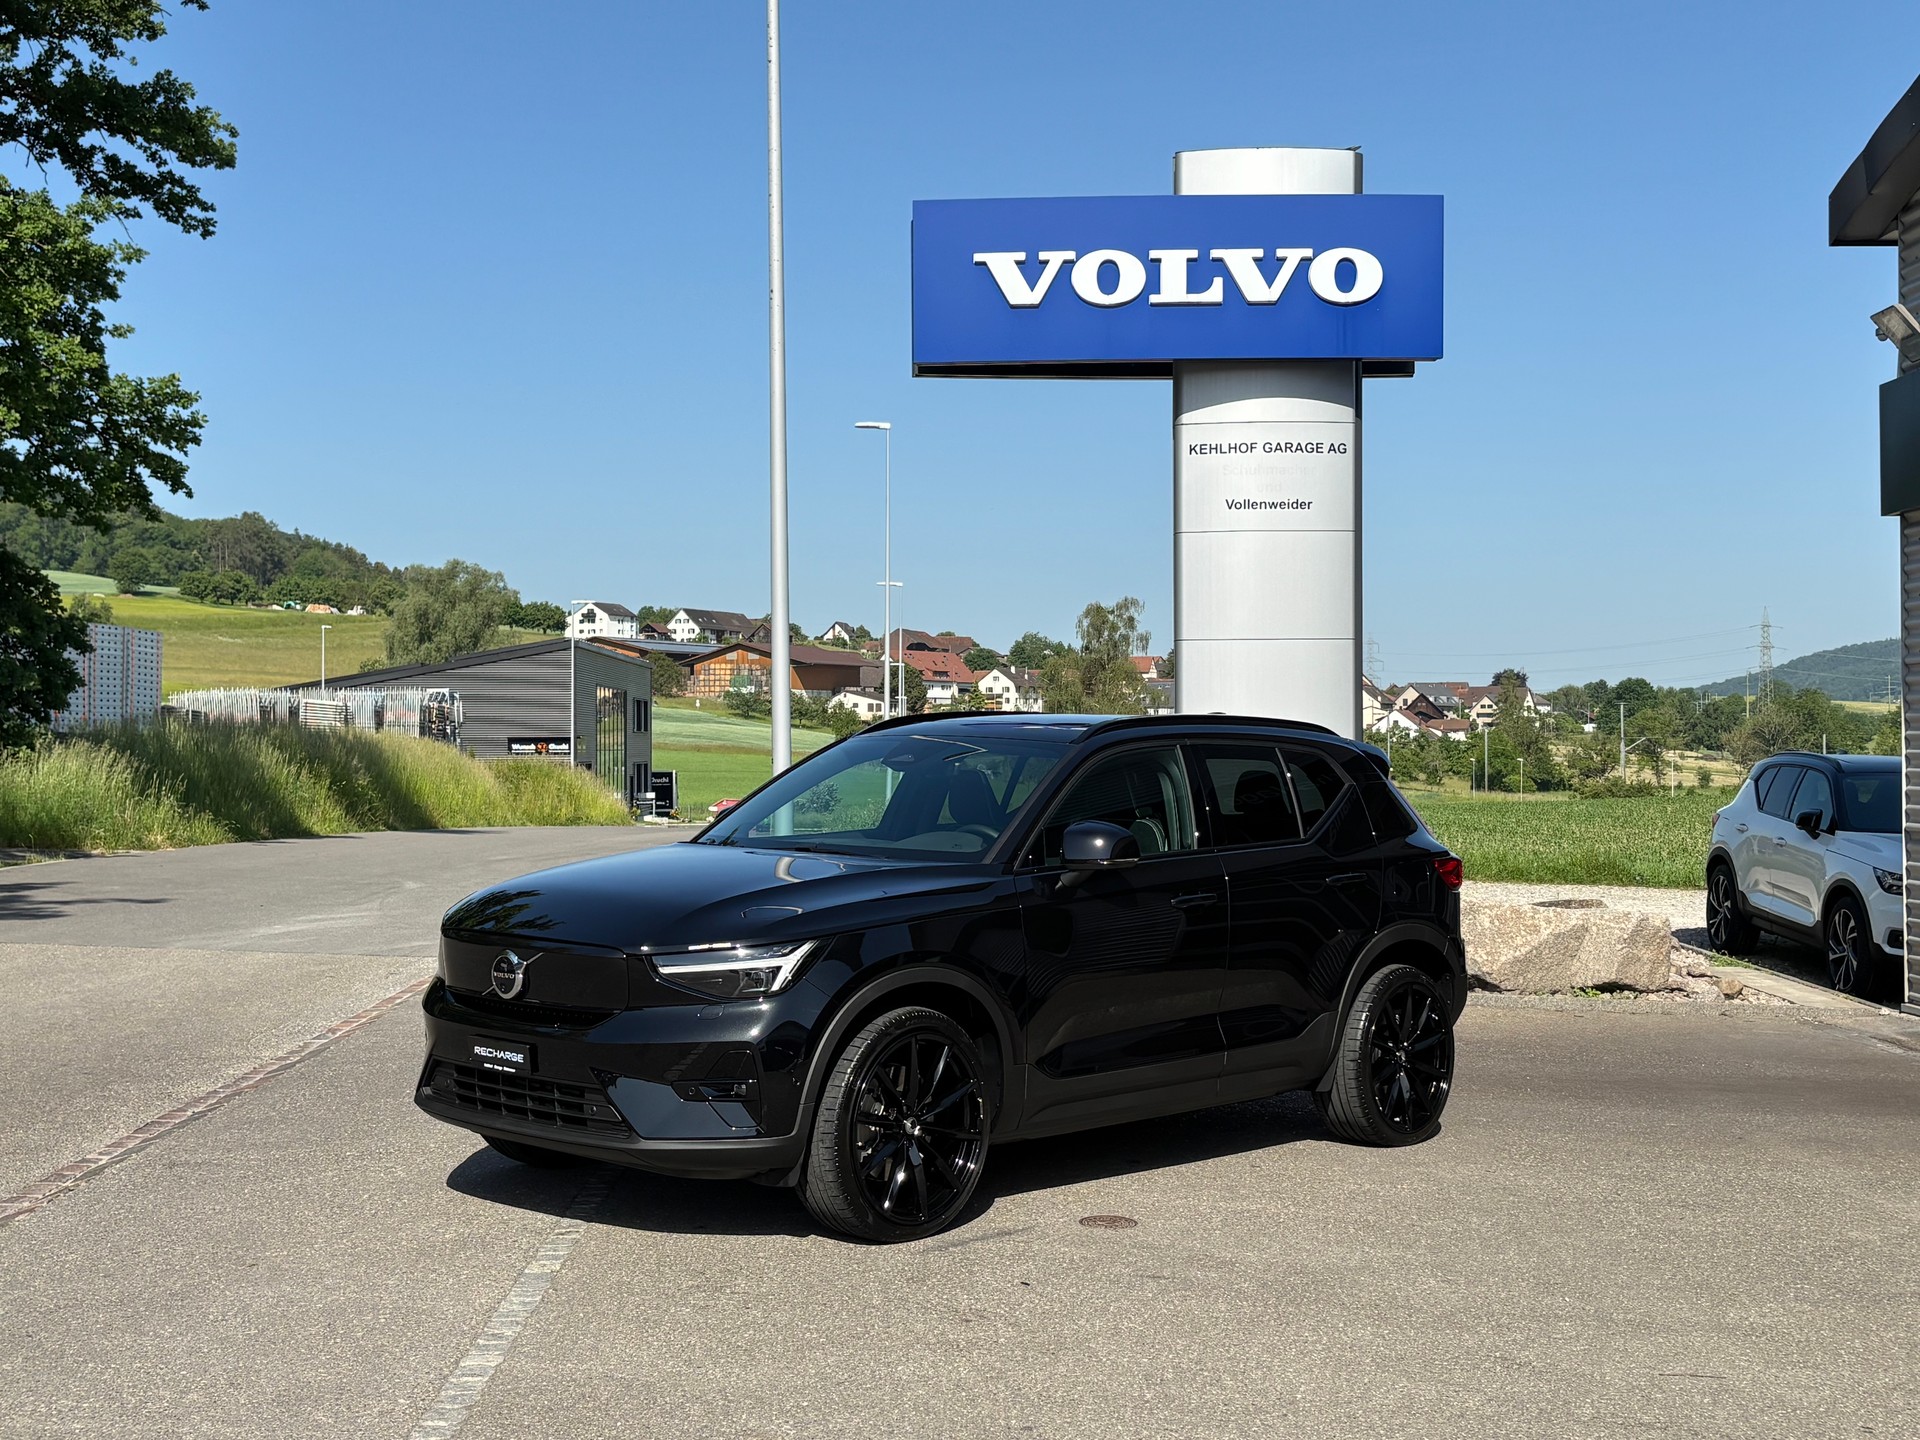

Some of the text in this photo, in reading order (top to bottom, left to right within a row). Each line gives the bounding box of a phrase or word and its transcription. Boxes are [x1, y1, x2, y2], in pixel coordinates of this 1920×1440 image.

[973, 247, 1384, 308] VOLVO
[1188, 441, 1348, 456] KEHLHOF GARAGE AG
[1225, 498, 1314, 511] Vollenweider
[493, 971, 515, 979] VOLVO
[474, 1045, 524, 1063] RECHARGE
